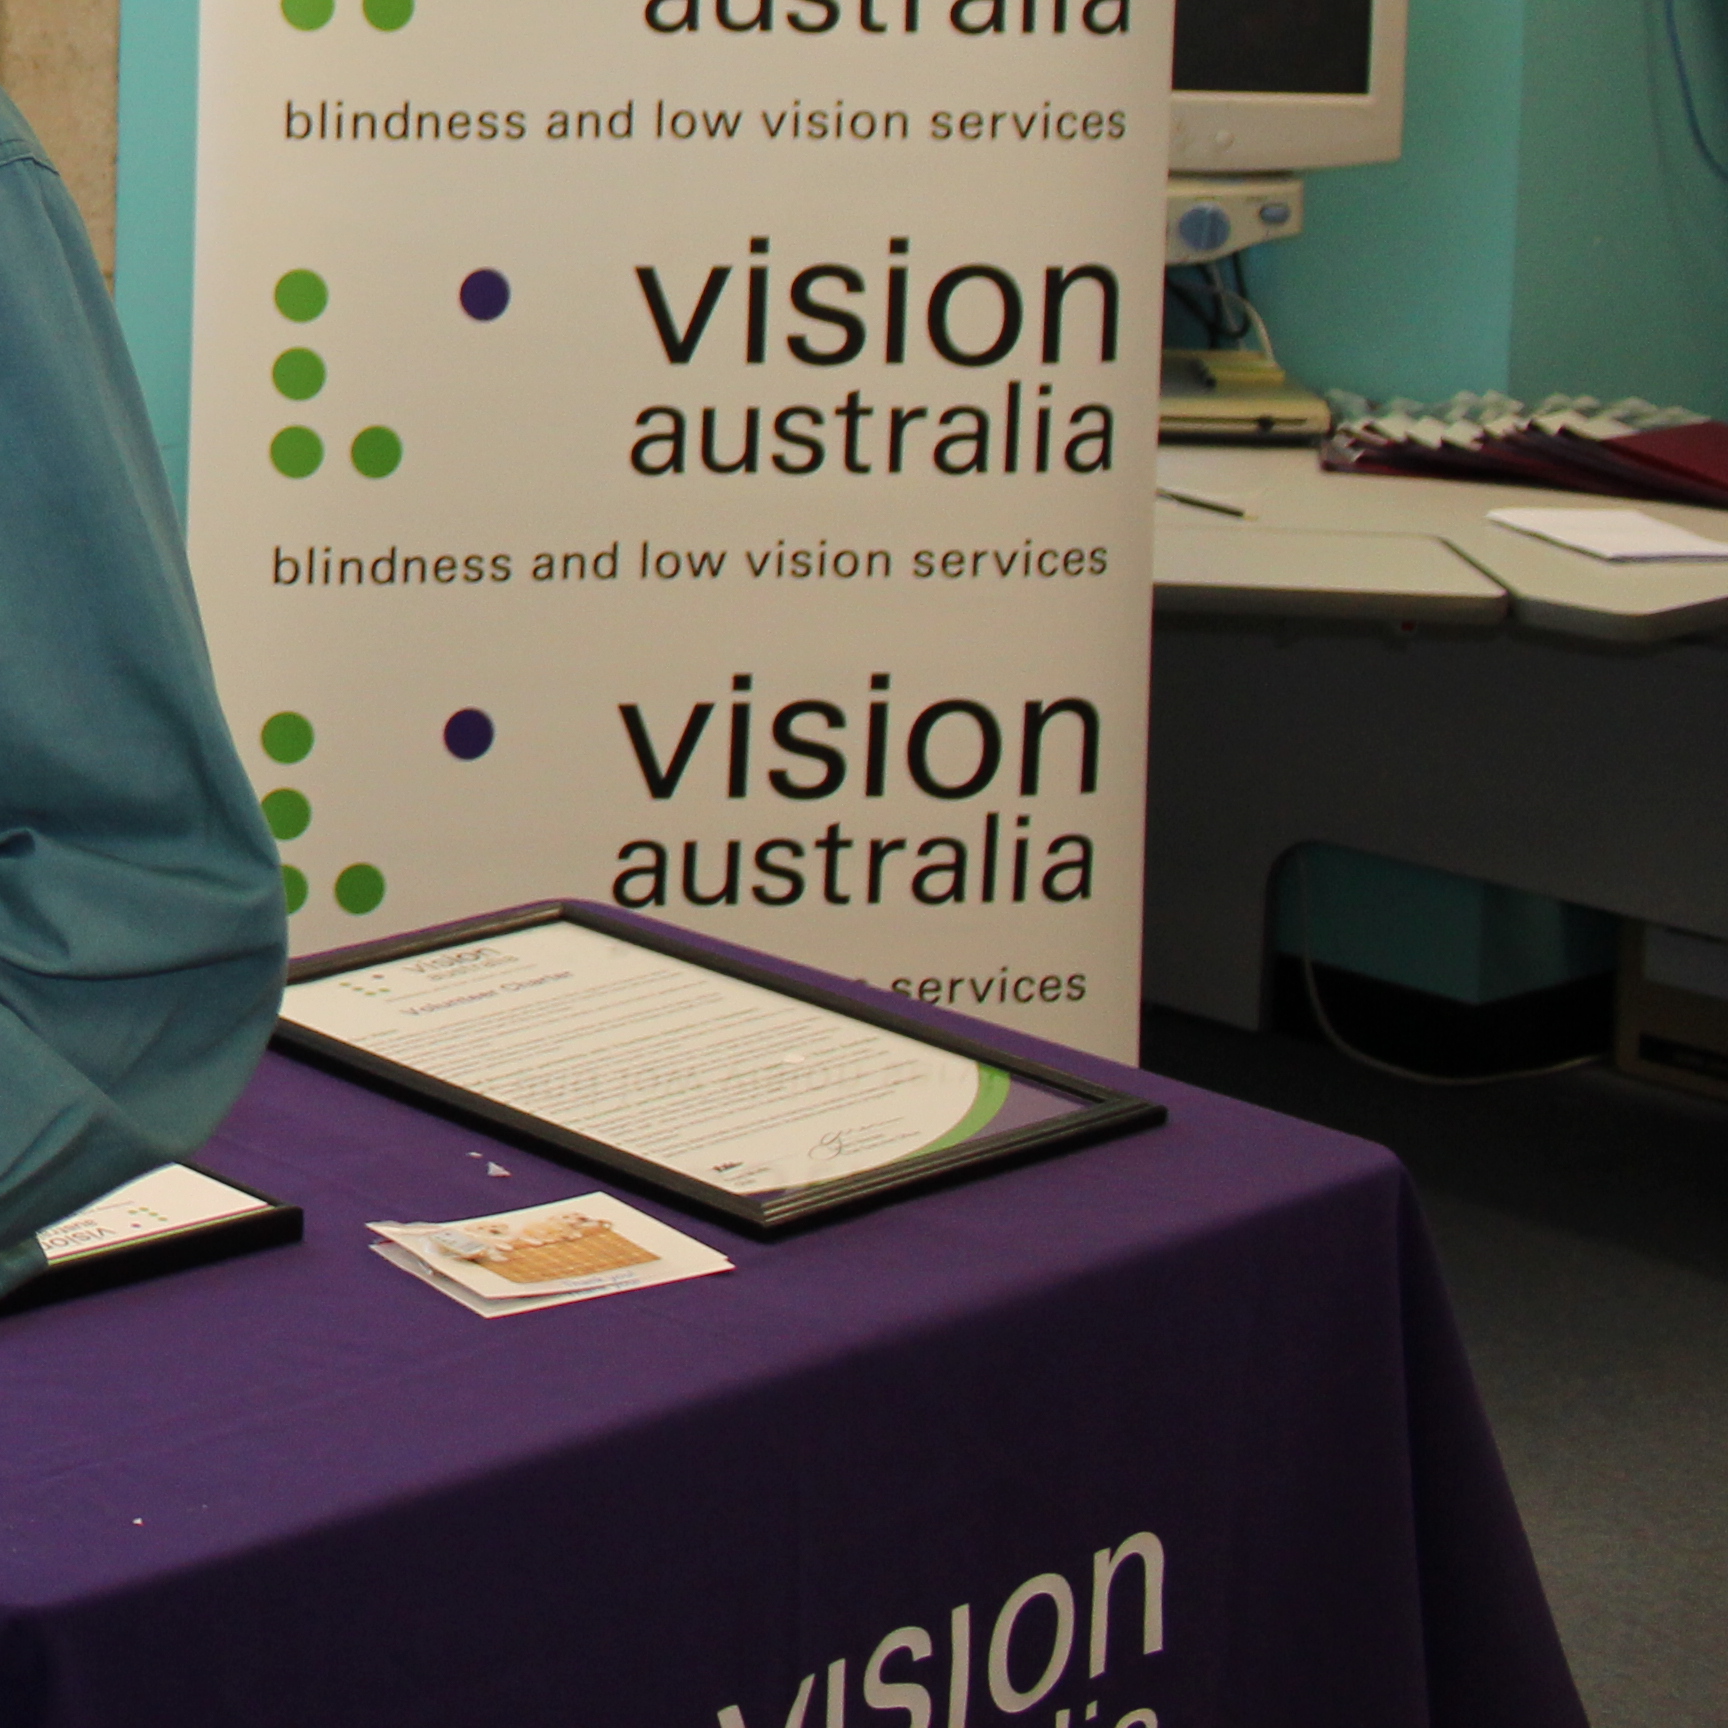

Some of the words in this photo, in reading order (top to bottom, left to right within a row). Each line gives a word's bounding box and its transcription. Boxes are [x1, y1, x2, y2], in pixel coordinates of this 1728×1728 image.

[286, 101, 526, 140] blindness
[547, 100, 633, 139] and
[656, 100, 742, 139] low
[762, 100, 908, 140] vision
[931, 101, 1126, 140] services
[635, 237, 1119, 368] vision
[630, 380, 1114, 476] australia
[273, 546, 511, 585] blindness
[532, 541, 618, 582] and
[641, 541, 727, 580] low
[746, 540, 891, 578] vision
[913, 539, 1107, 578] services
[618, 673, 1100, 801] vision
[611, 812, 1093, 911] australia
[891, 966, 1086, 1005] services
